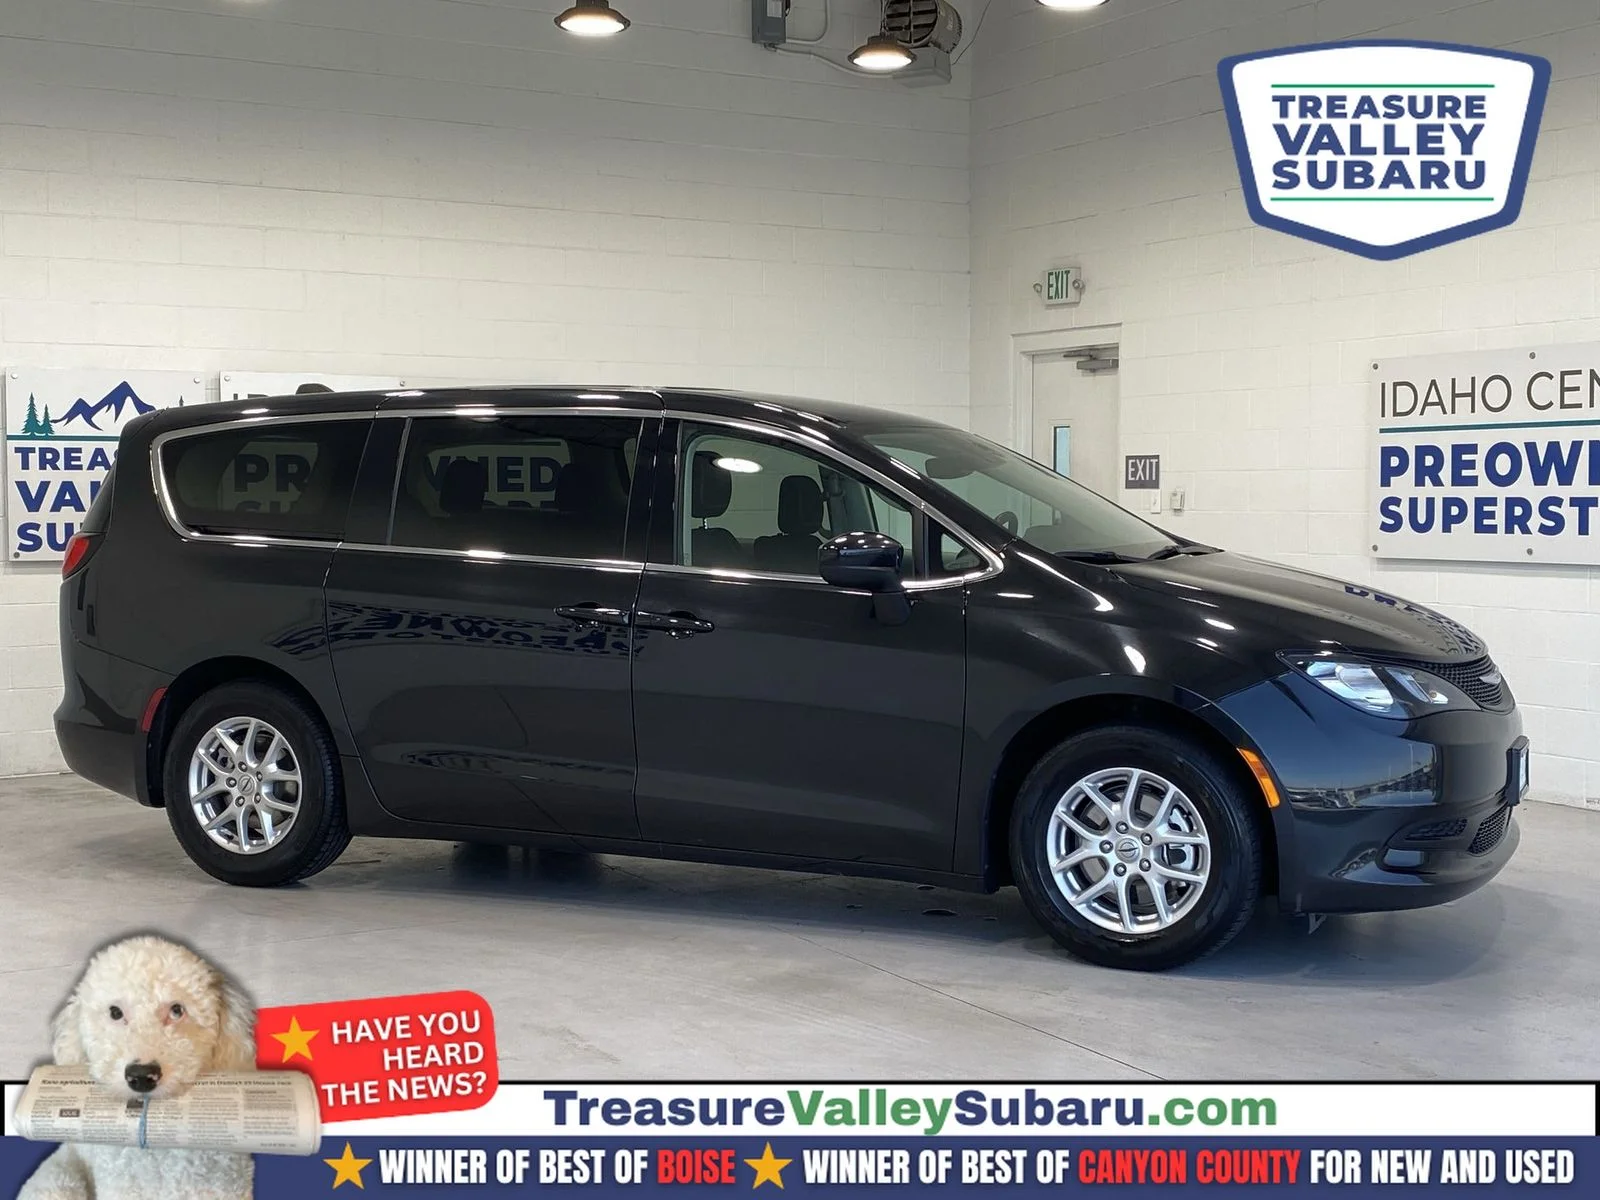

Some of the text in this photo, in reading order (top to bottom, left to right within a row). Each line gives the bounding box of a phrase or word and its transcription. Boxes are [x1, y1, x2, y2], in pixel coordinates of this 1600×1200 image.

[1047, 270, 1071, 300] EXIT
[1380, 374, 1511, 418] IDAHO
[14, 446, 118, 471] TREA
[1128, 458, 1159, 481] EXIT
[1379, 495, 1599, 536] SUPERST
[16, 521, 83, 553] SU
